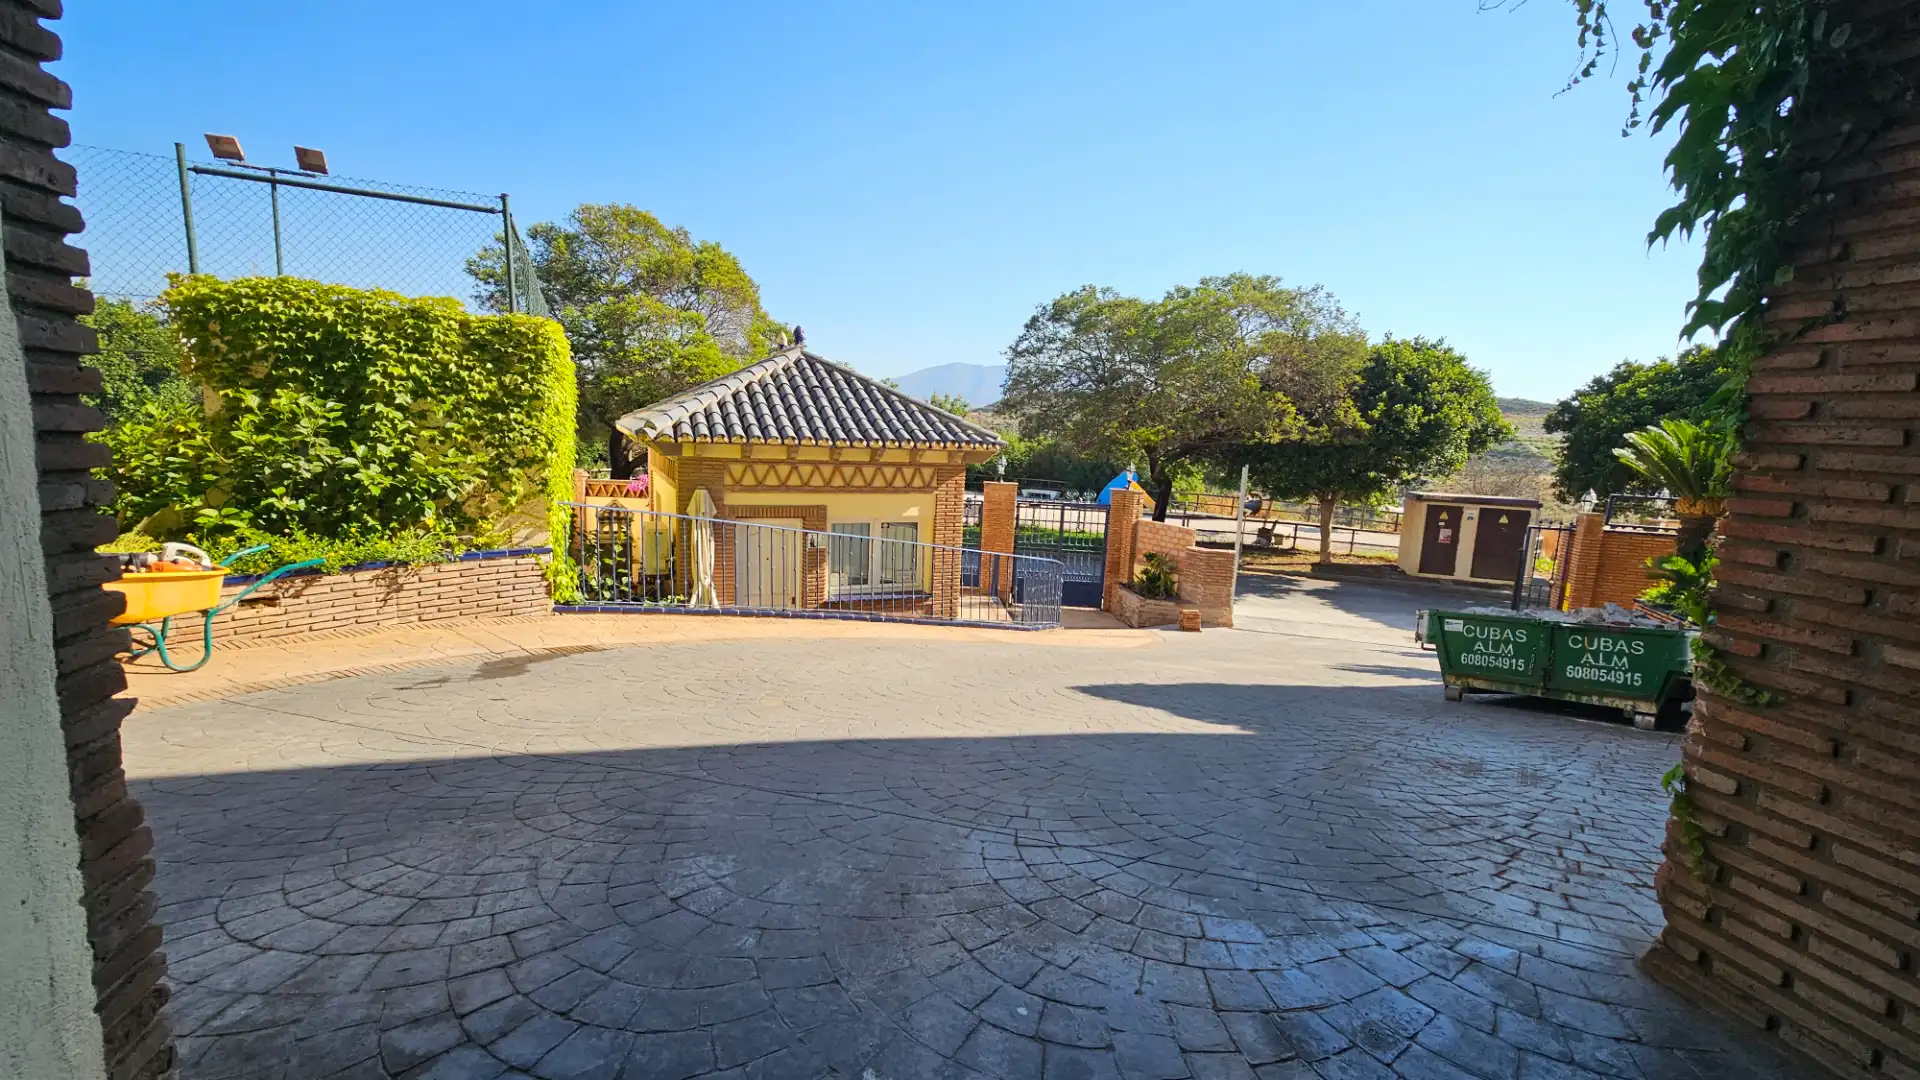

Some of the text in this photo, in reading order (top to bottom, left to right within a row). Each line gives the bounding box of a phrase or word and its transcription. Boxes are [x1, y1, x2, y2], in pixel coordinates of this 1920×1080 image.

[1463, 625, 1527, 642] CUBAS
[1473, 641, 1514, 655] ALM
[1568, 635, 1645, 655] CUBAS
[1461, 653, 1525, 671] 608054915
[1580, 652, 1629, 669] ALM
[1566, 665, 1642, 686] 608054915
